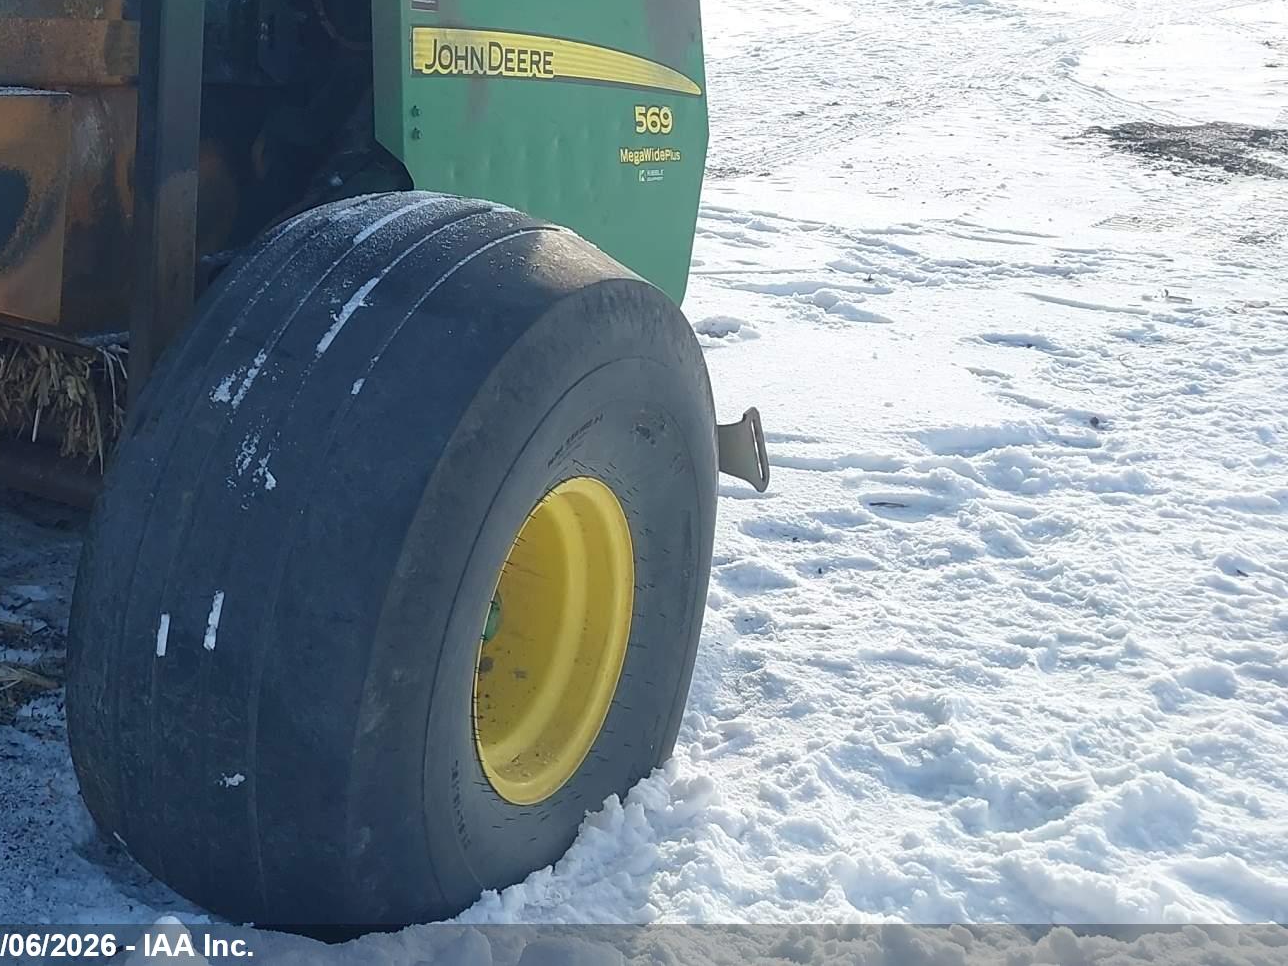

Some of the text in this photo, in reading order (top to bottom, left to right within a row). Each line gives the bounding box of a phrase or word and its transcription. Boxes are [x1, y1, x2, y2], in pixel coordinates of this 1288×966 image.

[425, 38, 554, 74] JOHN DEERE
[635, 105, 673, 134] 569
